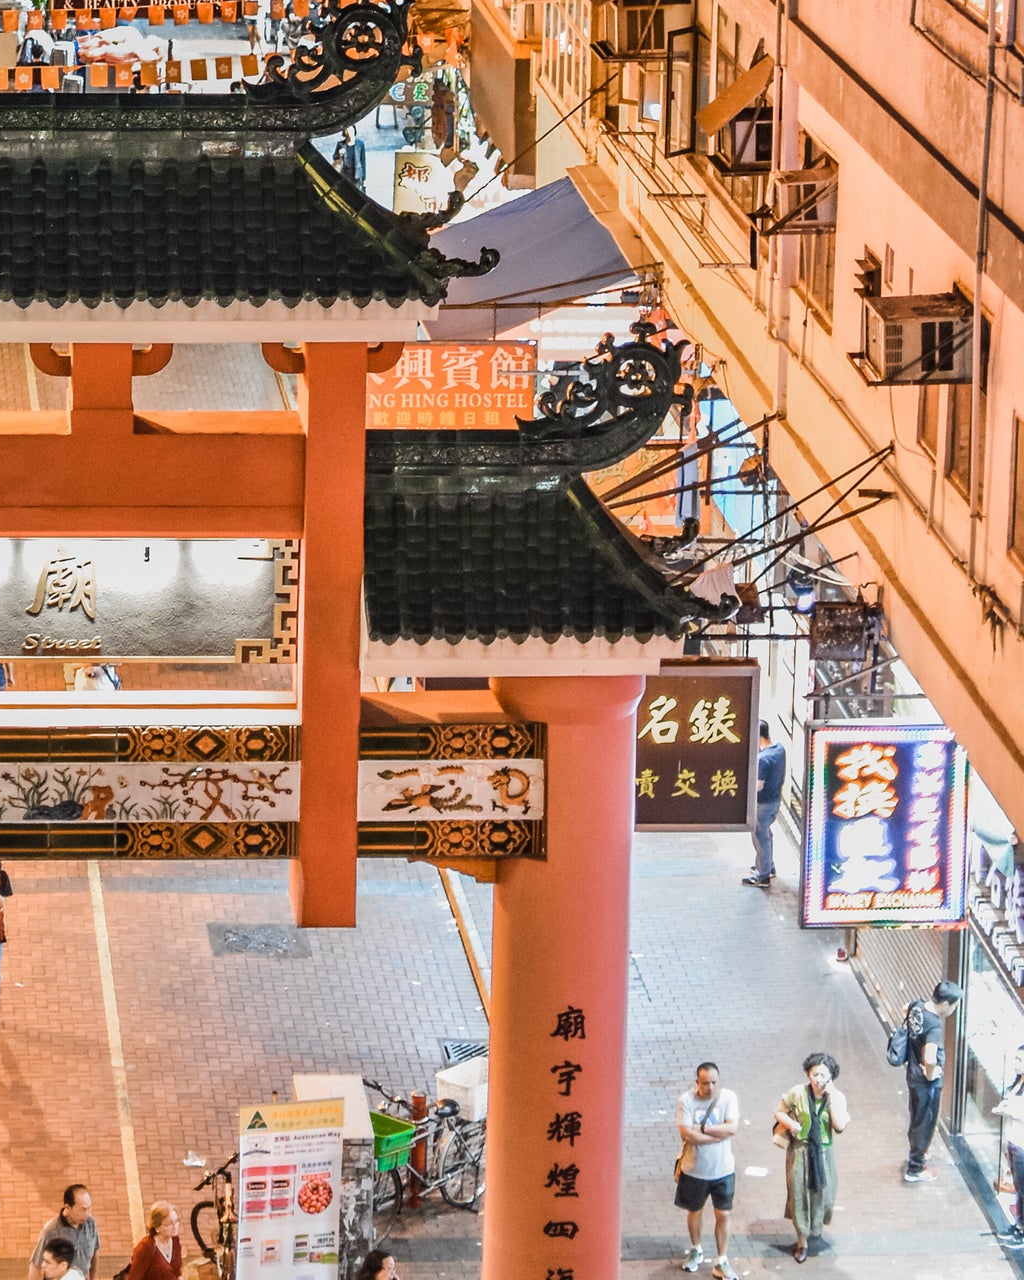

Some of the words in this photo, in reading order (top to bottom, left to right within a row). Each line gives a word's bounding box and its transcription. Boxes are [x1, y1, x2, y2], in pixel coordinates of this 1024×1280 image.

[63, 0, 74, 9] &
[367, 346, 533, 390] 興賓館
[367, 393, 396, 408] NG
[401, 393, 449, 408] HING
[454, 393, 528, 408] HOSTEL
[21, 633, 102, 651] Street
